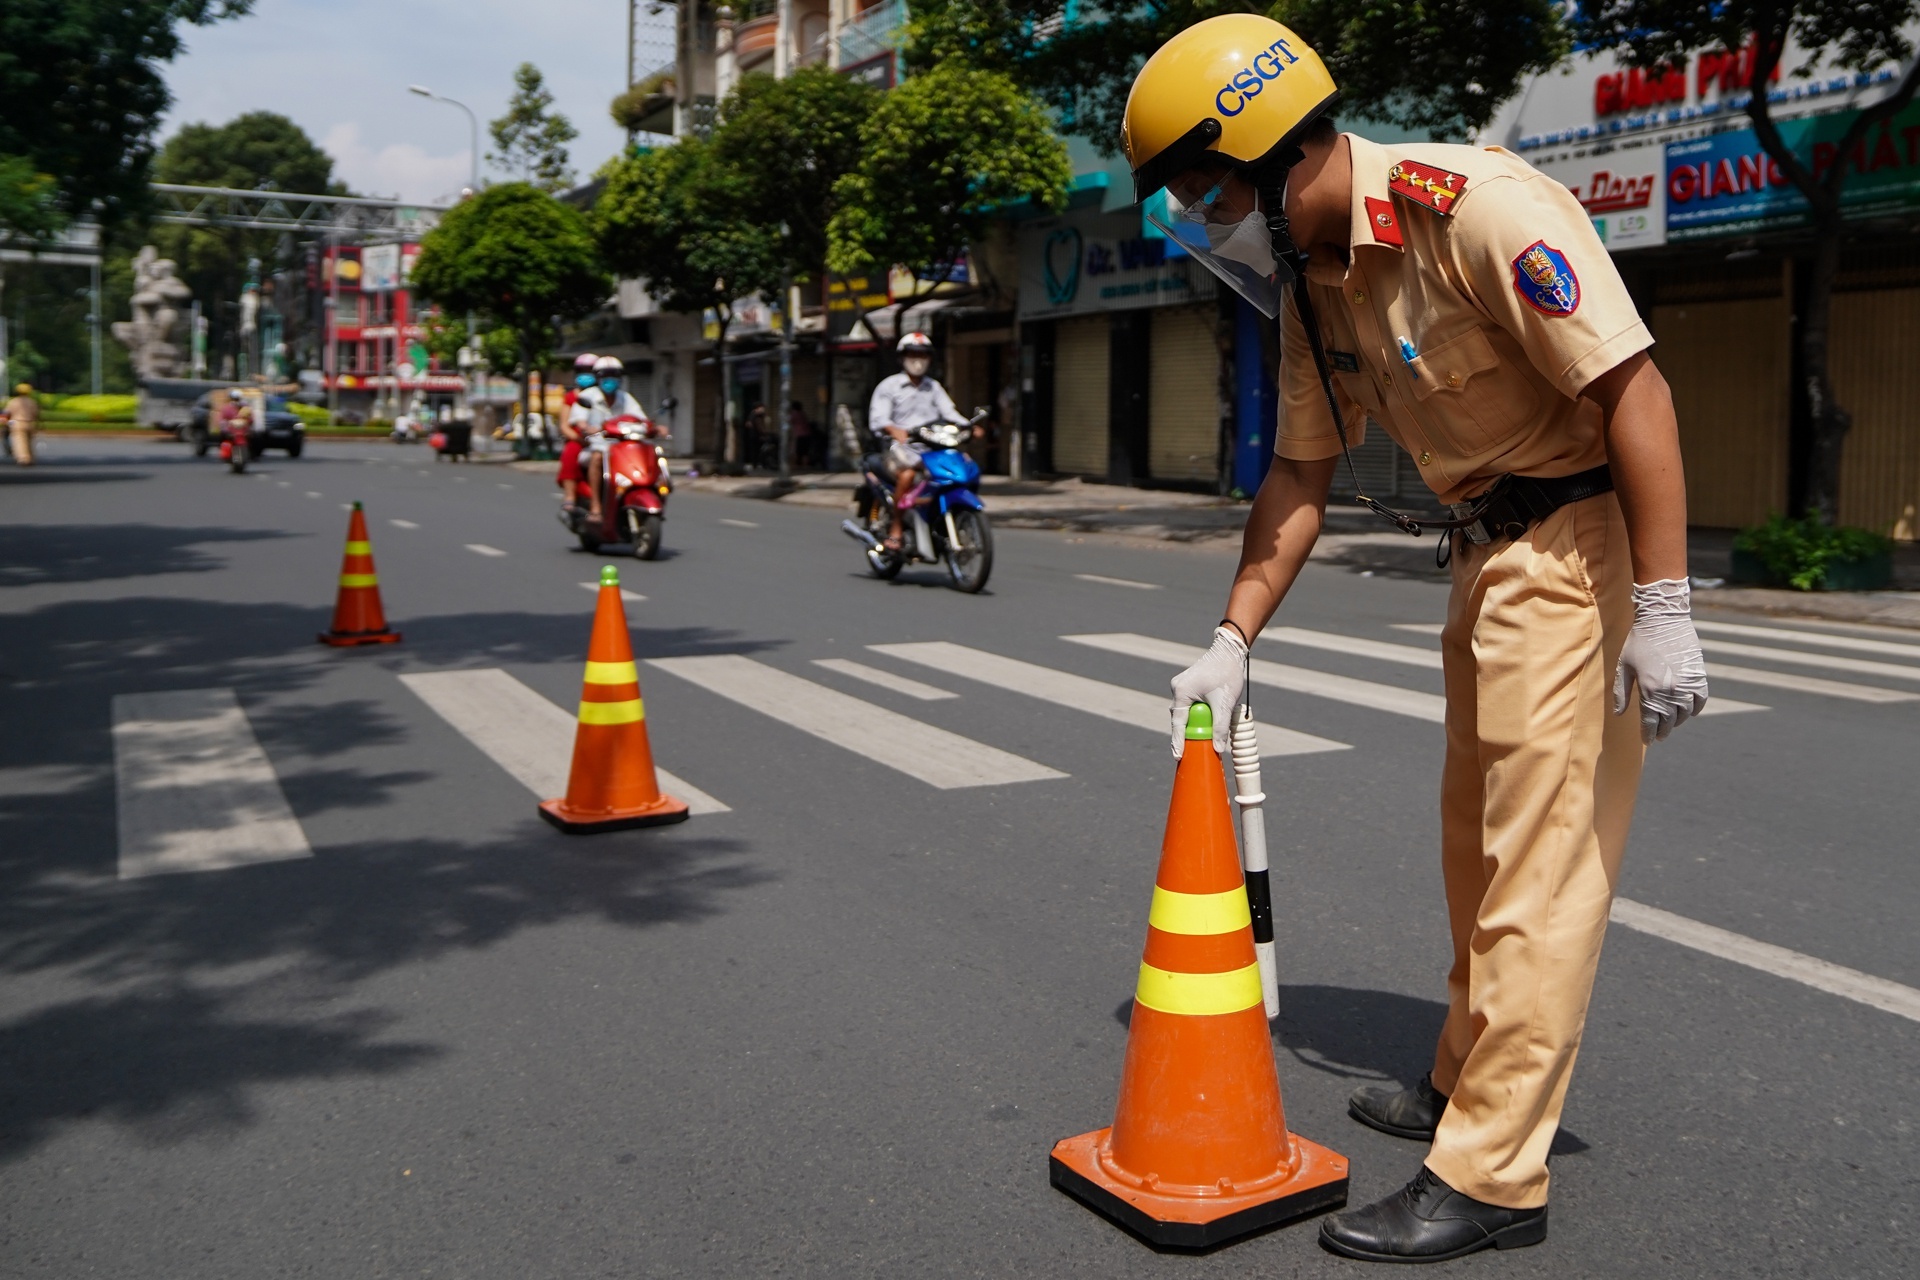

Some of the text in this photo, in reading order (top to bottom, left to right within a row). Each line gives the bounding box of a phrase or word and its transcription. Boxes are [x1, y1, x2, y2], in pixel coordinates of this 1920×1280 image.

[1215, 38, 1299, 118] CSGT
[1595, 66, 1687, 116] GIANG
[1535, 272, 1570, 302] CSGT
